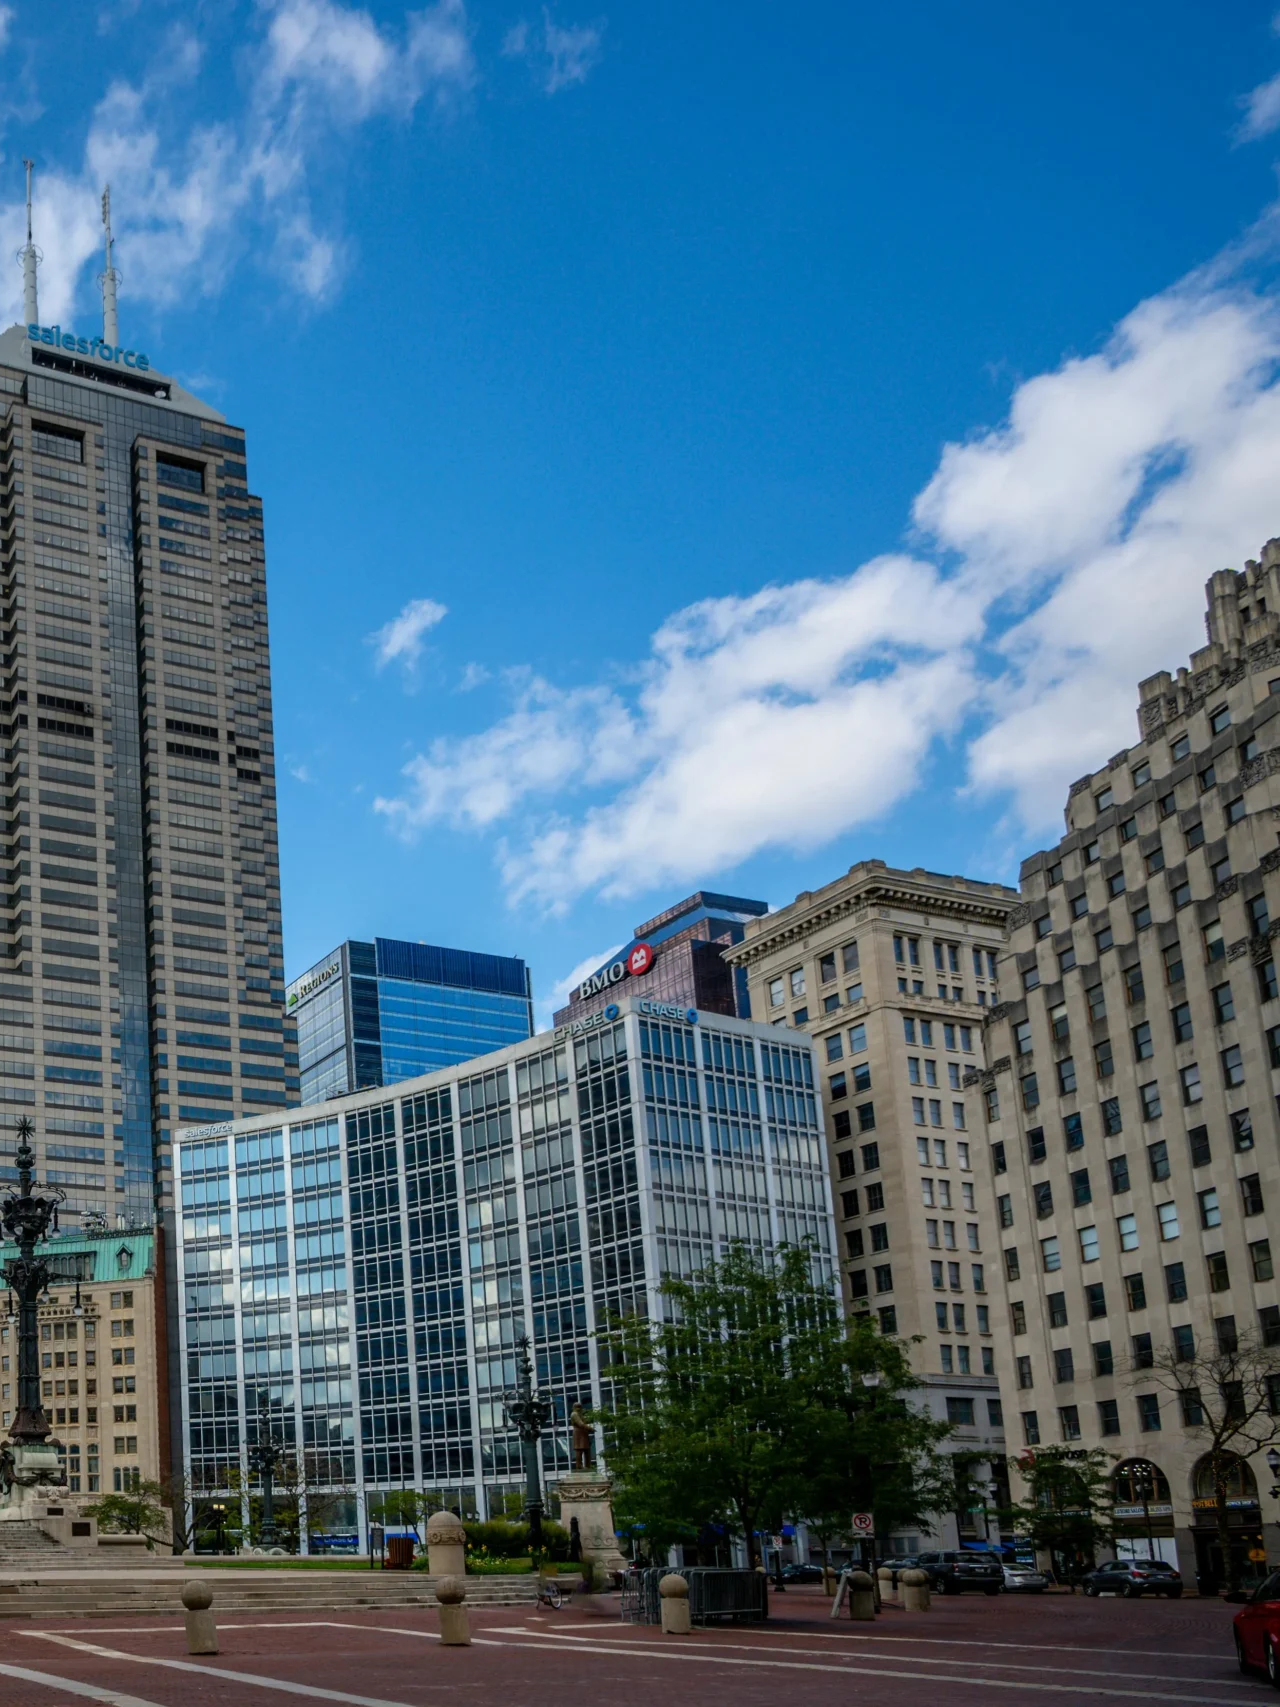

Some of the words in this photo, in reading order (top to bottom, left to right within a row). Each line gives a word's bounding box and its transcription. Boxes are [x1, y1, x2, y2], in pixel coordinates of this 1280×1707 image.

[299, 962, 340, 998] REGIONS
[579, 961, 625, 1000] BMO
[552, 1010, 604, 1042] CHASE
[640, 1001, 685, 1021] CHASE
[184, 1123, 233, 1138] salesforce
[27, 1323, 150, 1371] salesforce
